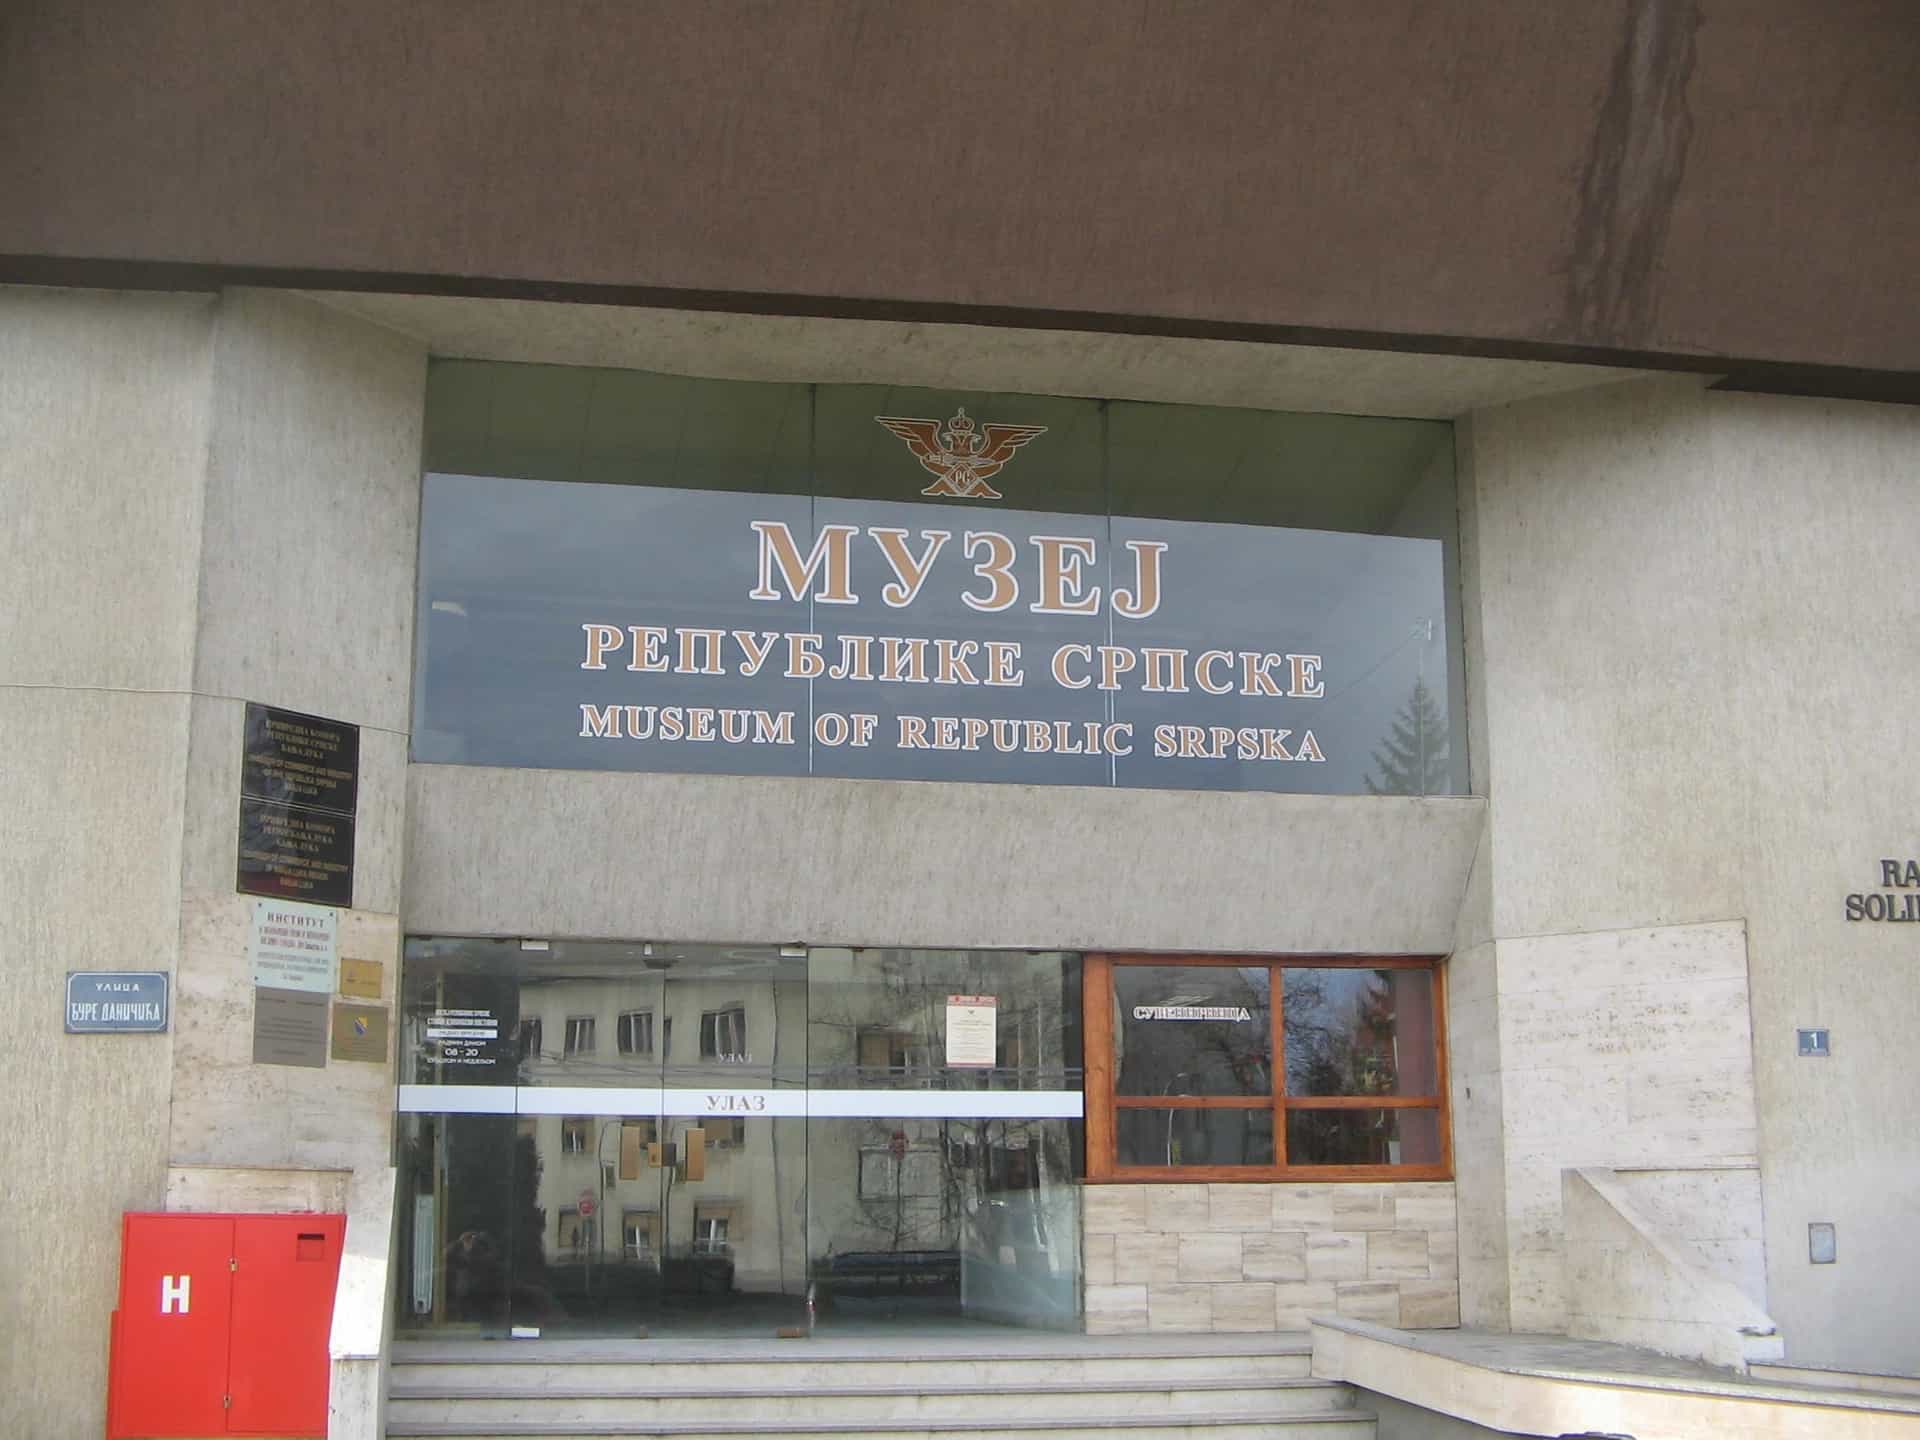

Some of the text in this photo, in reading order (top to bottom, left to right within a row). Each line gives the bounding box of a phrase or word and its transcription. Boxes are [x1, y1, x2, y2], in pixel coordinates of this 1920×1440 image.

[749, 520, 1168, 619] МУЗЕЈ
[581, 624, 1325, 698] РЕПУБЛИКЕ СРПСКЕ
[579, 704, 1327, 763] MUSEUM OF REPUBLIC SRPSKA
[267, 911, 324, 928] ИНСТИТУТ
[1846, 893, 1920, 922] SOLI
[95, 983, 140, 992] УЛИЦА
[101, 1002, 160, 1022] ДАНИЧИЋА
[706, 1095, 766, 1112] УЛАЗ
[162, 1275, 190, 1312] H
